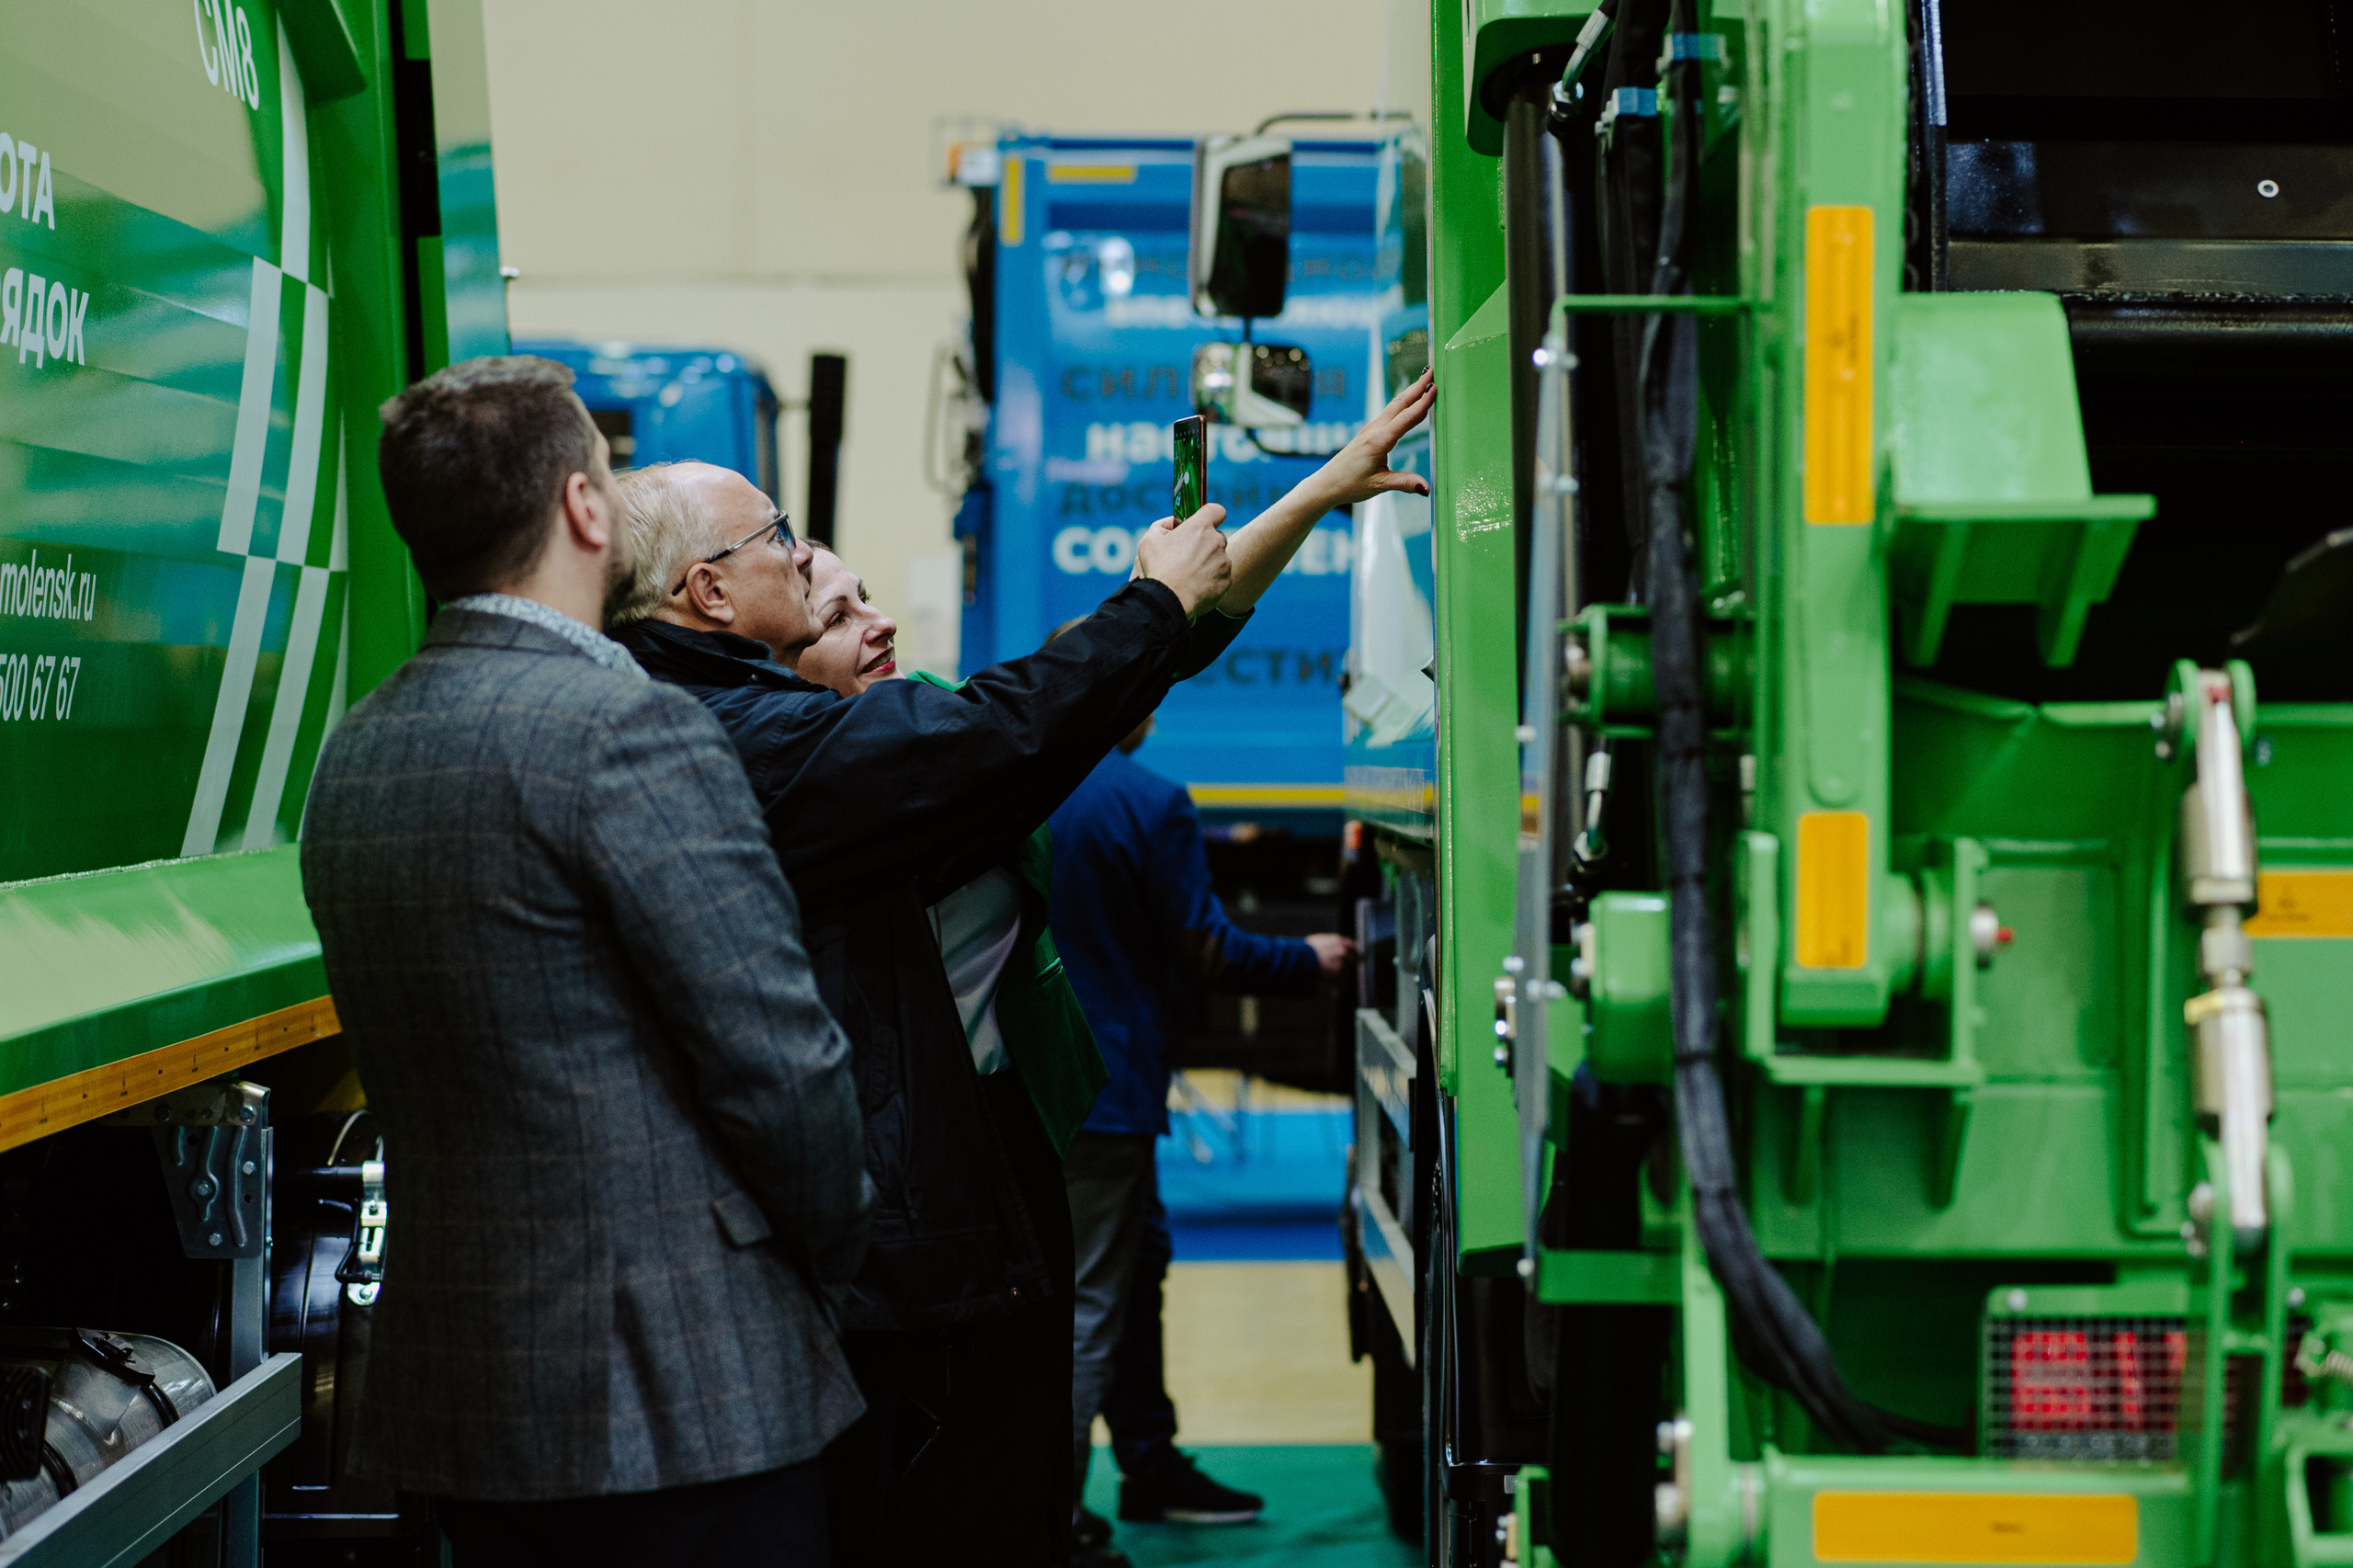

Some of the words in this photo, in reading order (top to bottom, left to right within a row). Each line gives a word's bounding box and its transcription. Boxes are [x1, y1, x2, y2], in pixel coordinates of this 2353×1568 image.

[0, 267, 90, 369] ЯДОК
[29, 654, 56, 721] 67
[55, 655, 81, 721] 67
